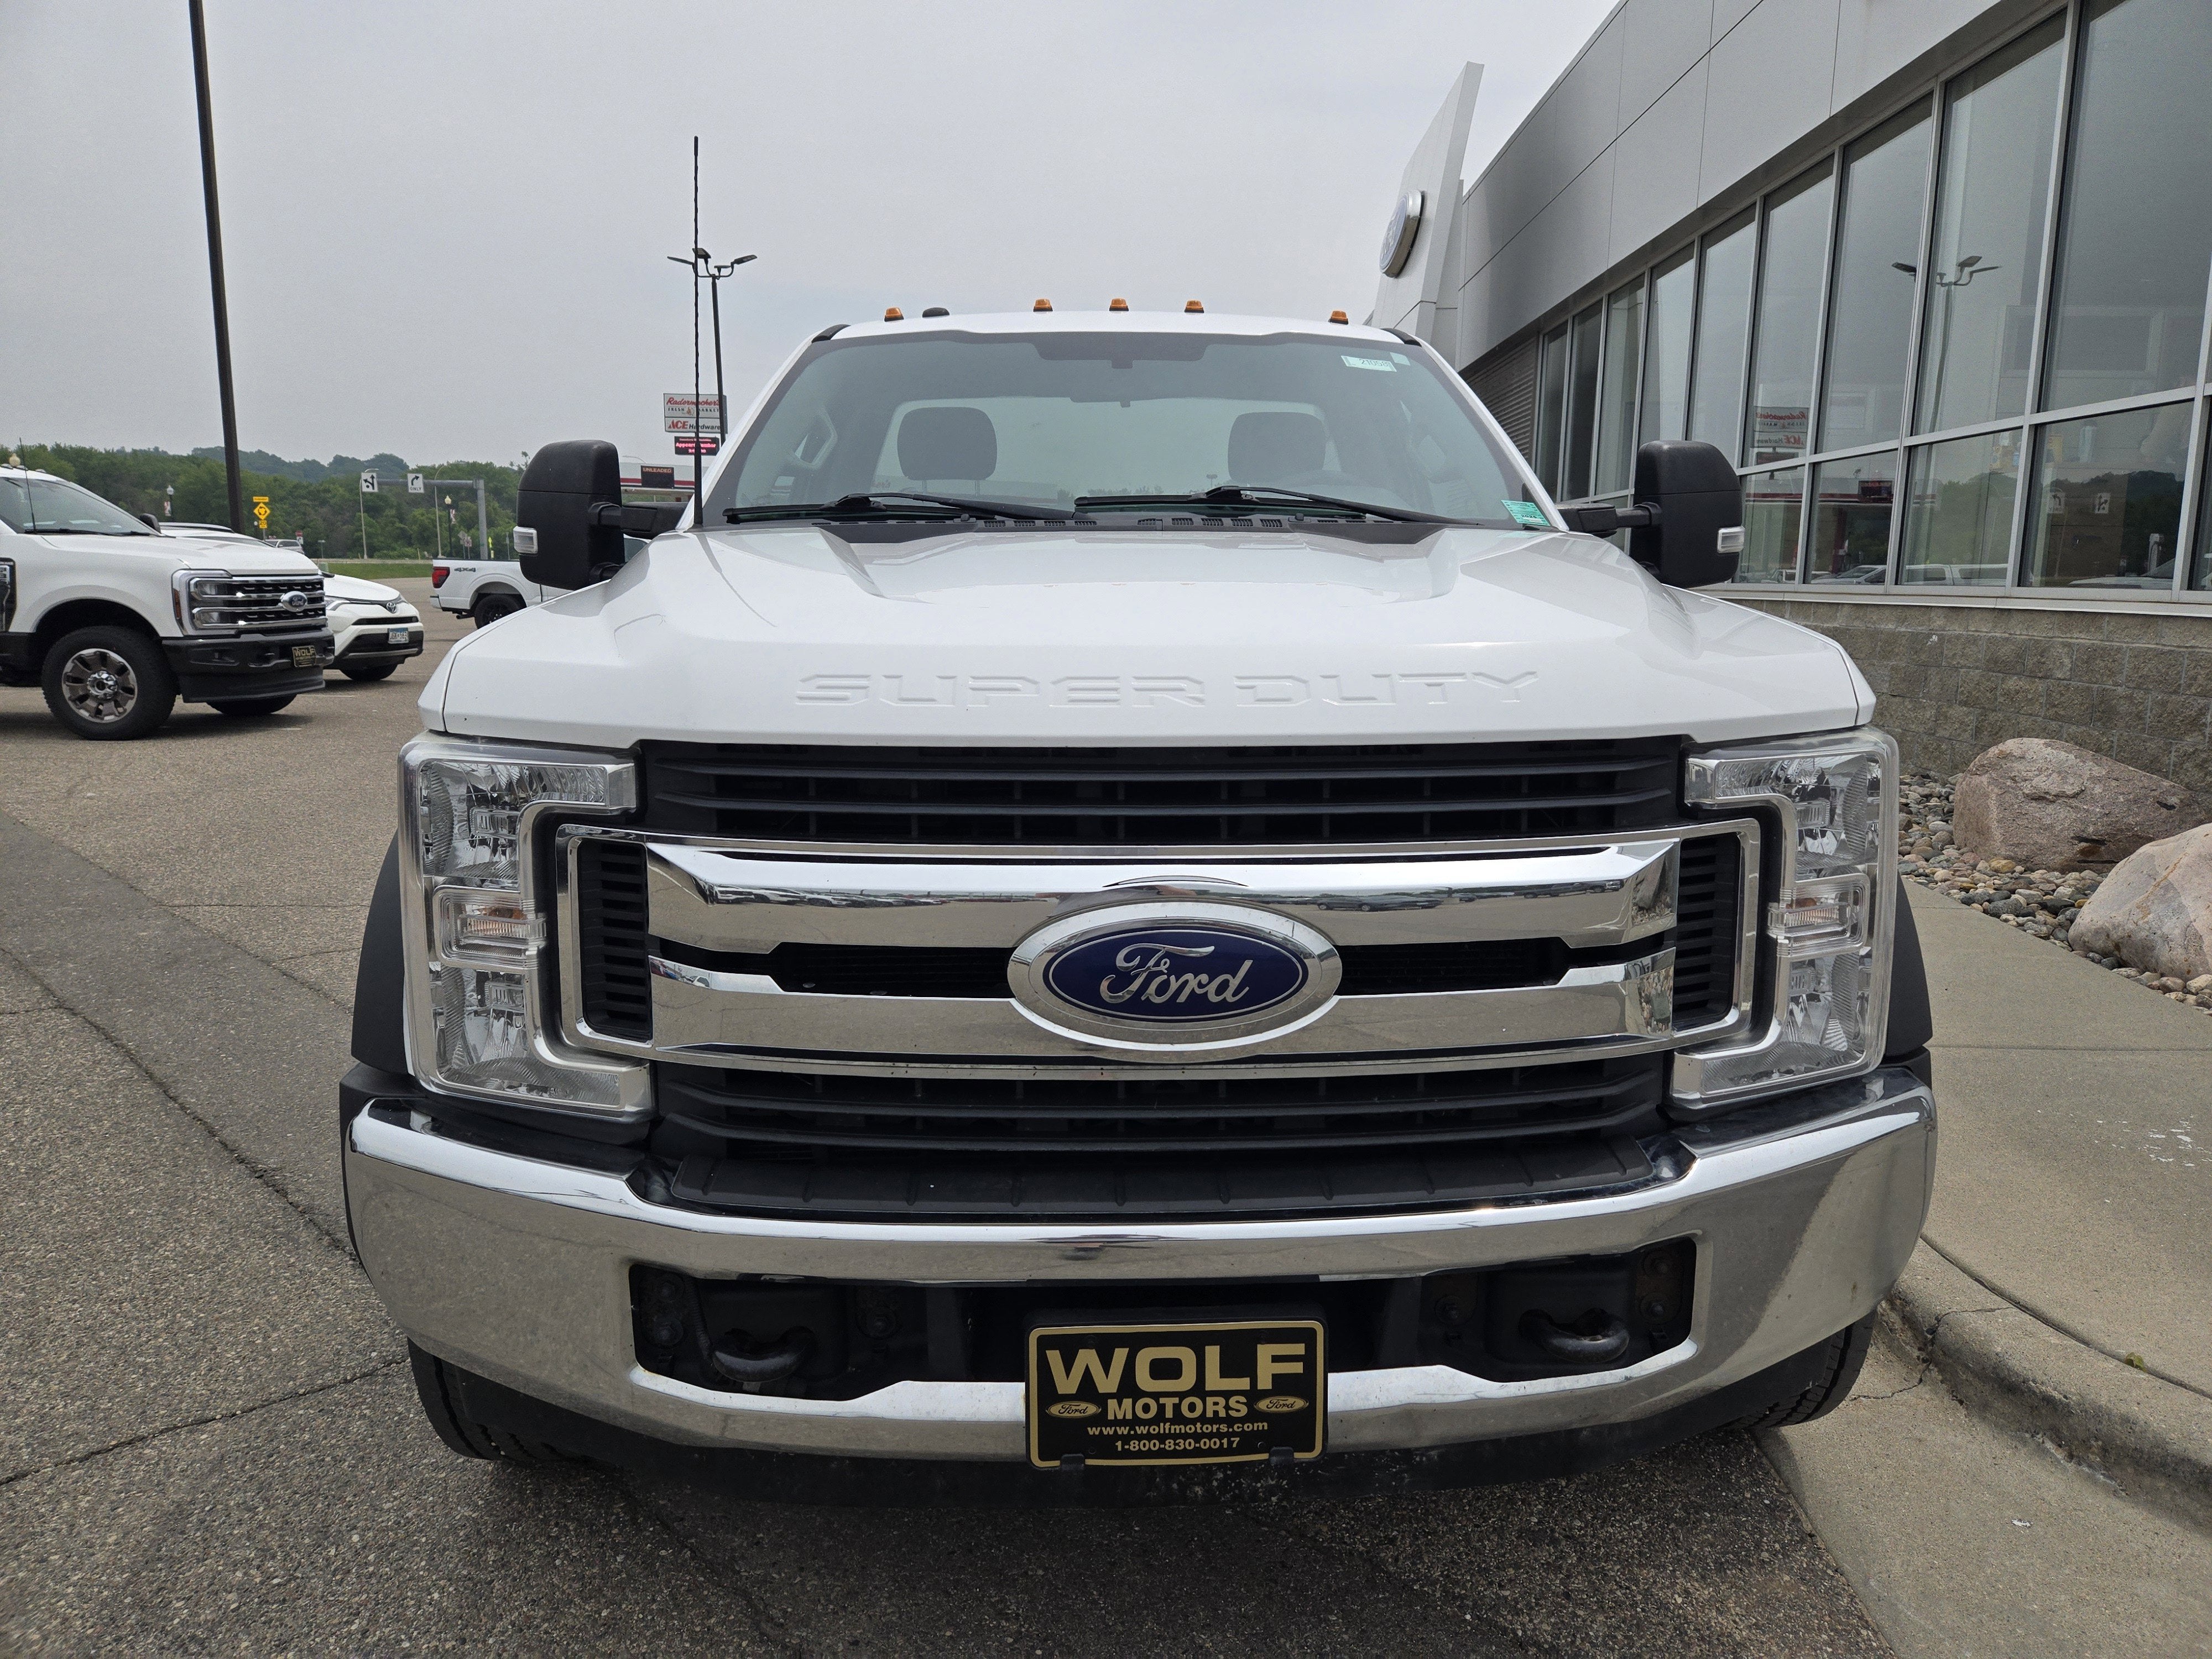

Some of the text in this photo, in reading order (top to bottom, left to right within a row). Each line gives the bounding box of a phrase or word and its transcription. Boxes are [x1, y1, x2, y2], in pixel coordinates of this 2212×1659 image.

[668, 420, 689, 430] ACE
[795, 671, 1539, 708] SUPER DUTY
[1100, 942, 1254, 1004] Ford
[1046, 1343, 1306, 1395] WOLF
[1107, 1396, 1249, 1420] MOTORS
[1087, 1421, 1268, 1436] www.wolfmotors.com
[1115, 1437, 1240, 1452] 1-800-830-0017
